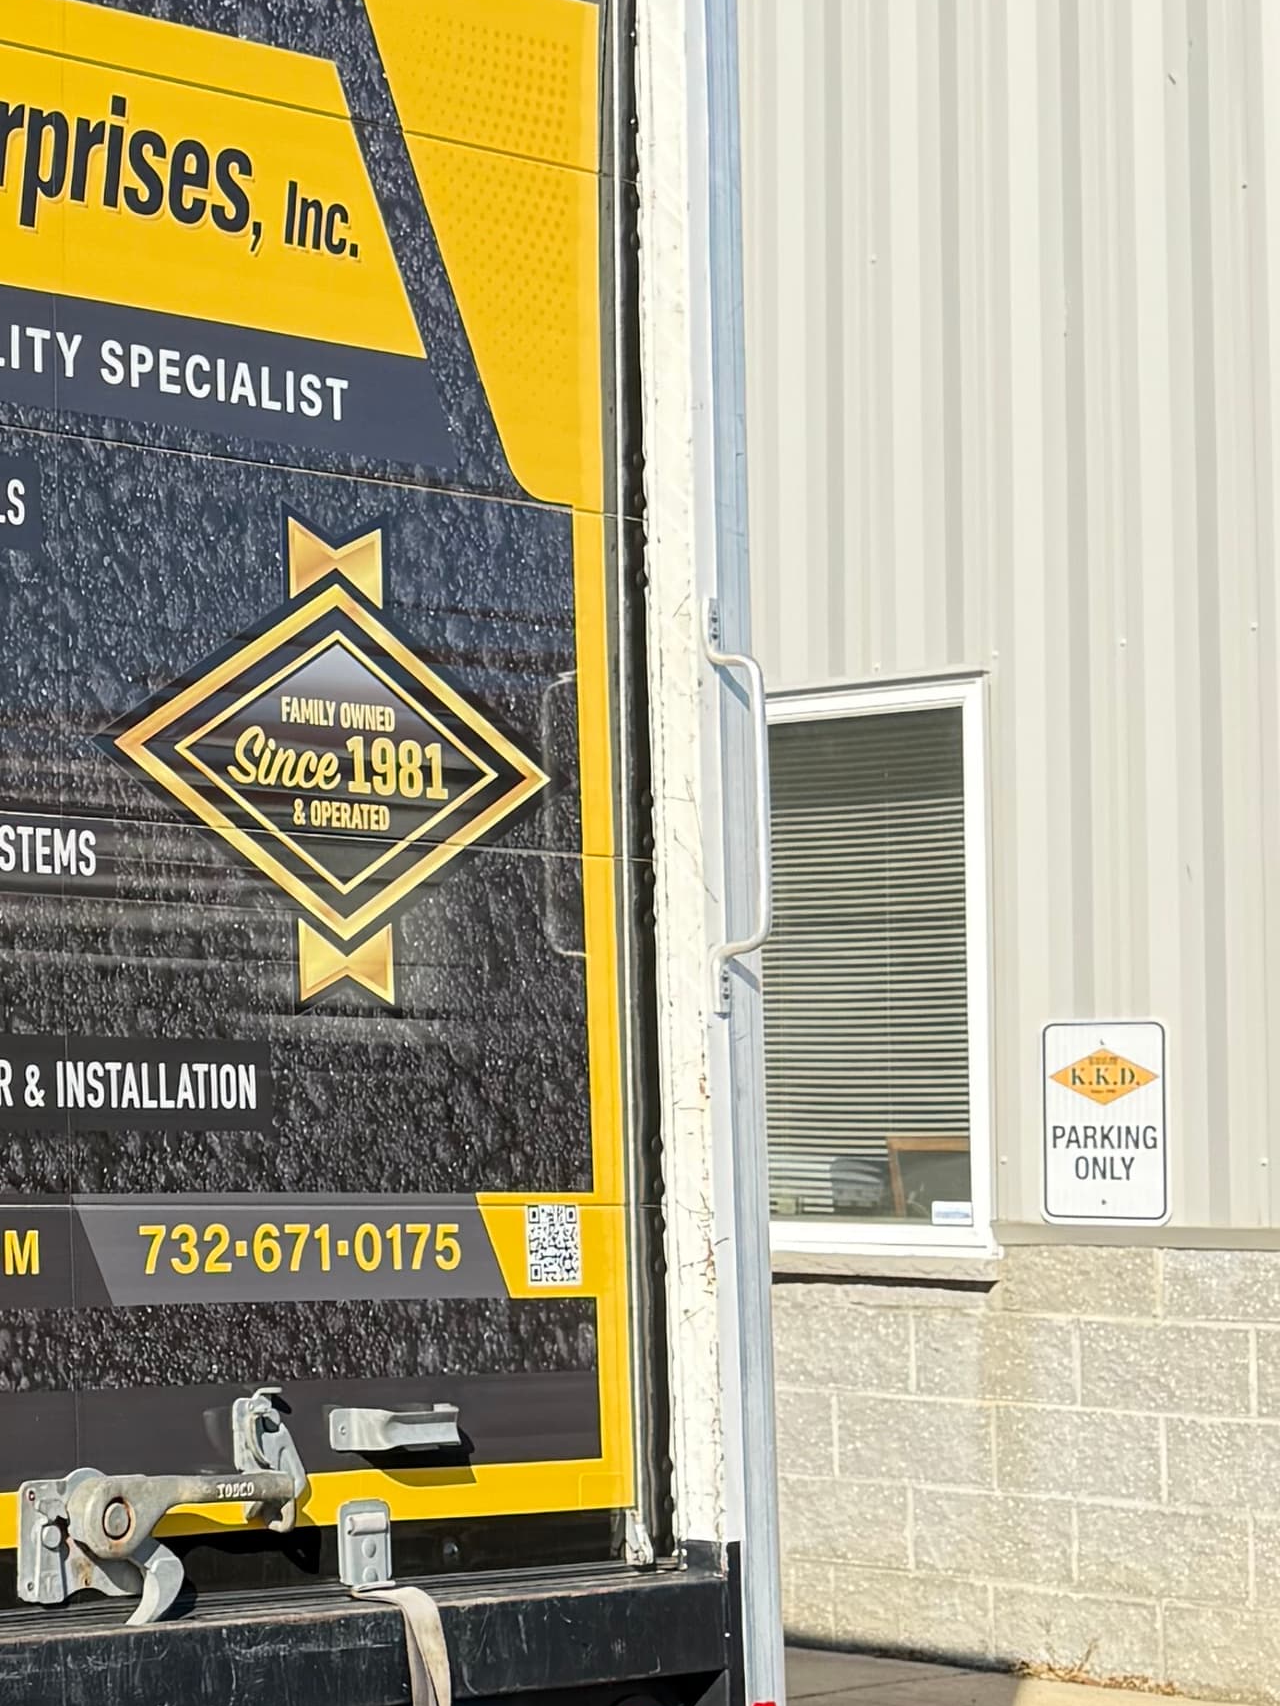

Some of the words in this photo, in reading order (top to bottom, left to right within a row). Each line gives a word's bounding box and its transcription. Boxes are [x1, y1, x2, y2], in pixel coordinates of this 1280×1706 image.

[284, 180, 359, 258] Inc.
[100, 338, 349, 421] SPECIALIST
[281, 696, 336, 726] FAMILY
[340, 702, 395, 731] OWNED
[227, 725, 340, 790] Since
[345, 736, 448, 800] 1981
[292, 798, 305, 826] &
[310, 800, 389, 831] OPERATED
[24, 1064, 45, 1108] &
[56, 1060, 256, 1110] INSTALLATION
[1071, 1068, 1140, 1086] K.K.D.
[1052, 1126, 1158, 1149] PARKING
[1075, 1156, 1135, 1180] ONLY
